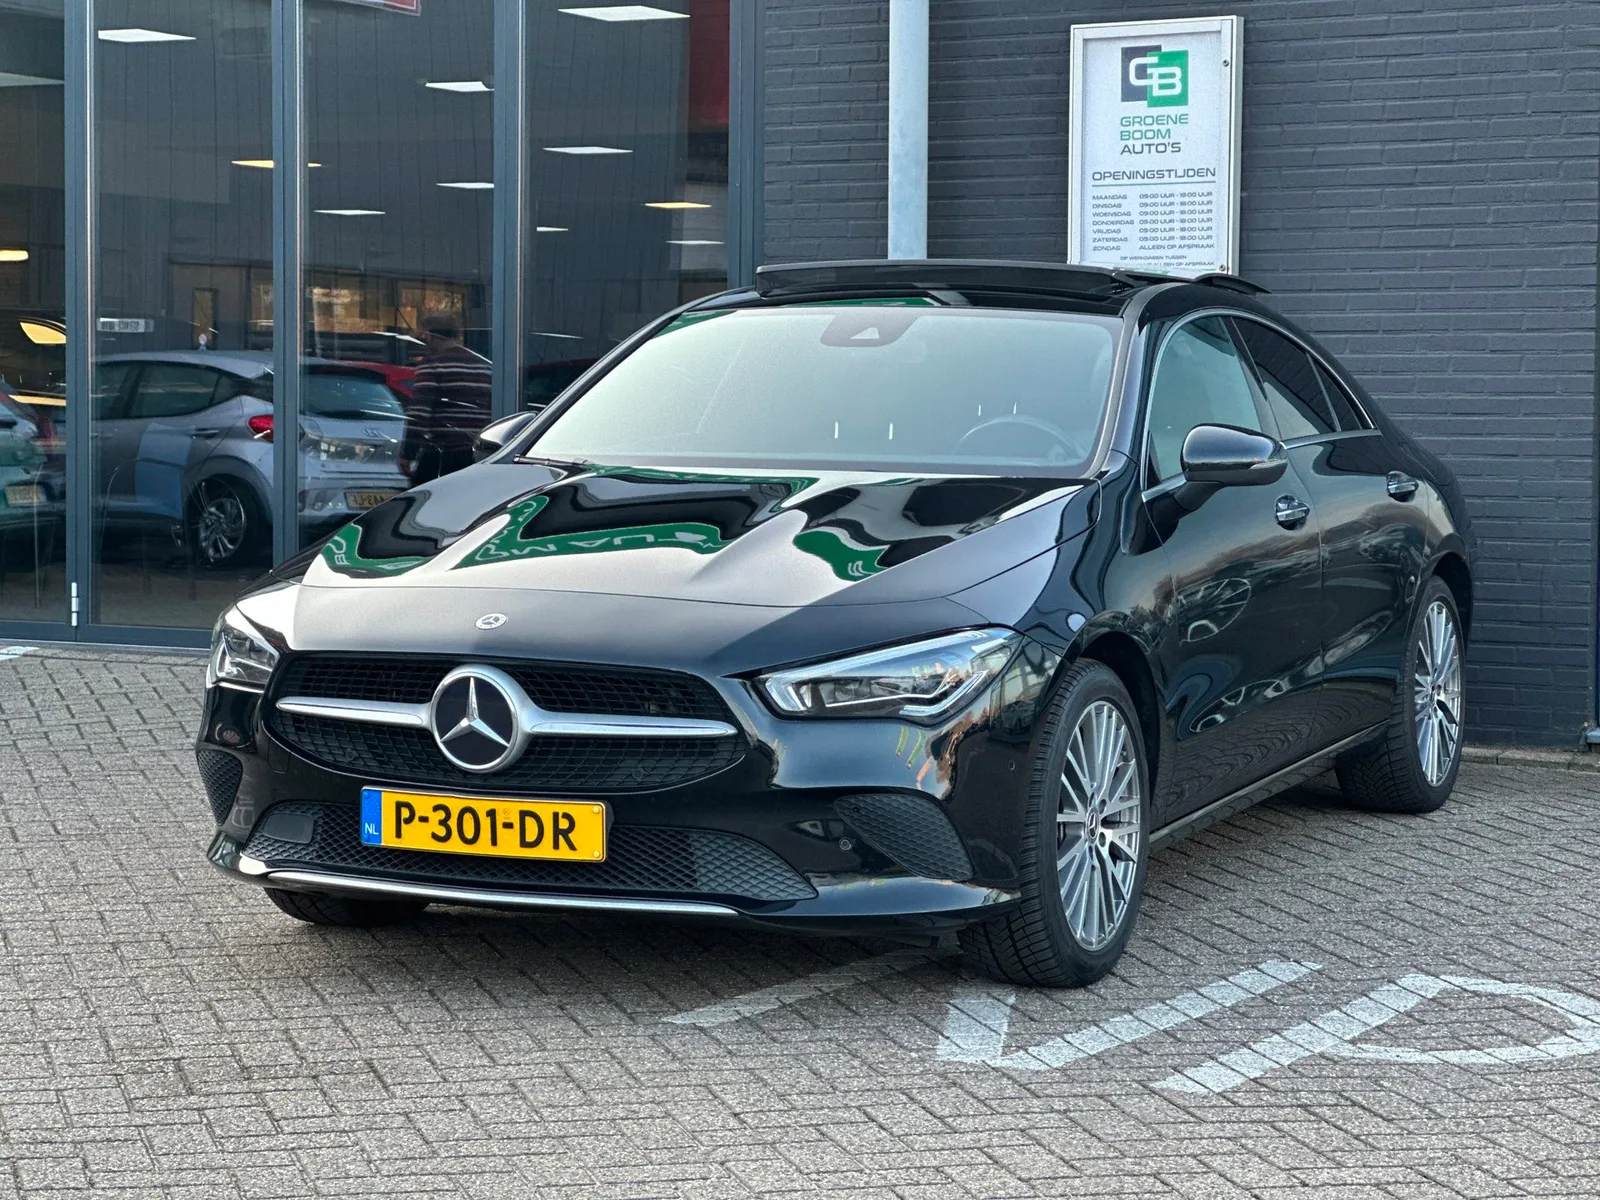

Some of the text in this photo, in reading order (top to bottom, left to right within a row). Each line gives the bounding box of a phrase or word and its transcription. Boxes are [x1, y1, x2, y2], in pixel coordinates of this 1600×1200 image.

[1120, 114, 1189, 127] GROENE
[1120, 128, 1171, 141] BOOM
[1120, 142, 1181, 155] AUTO'S
[1092, 168, 1216, 181] OPENINGSTIJDEN
[364, 822, 379, 835] NL
[394, 800, 578, 851] P-301-DR
